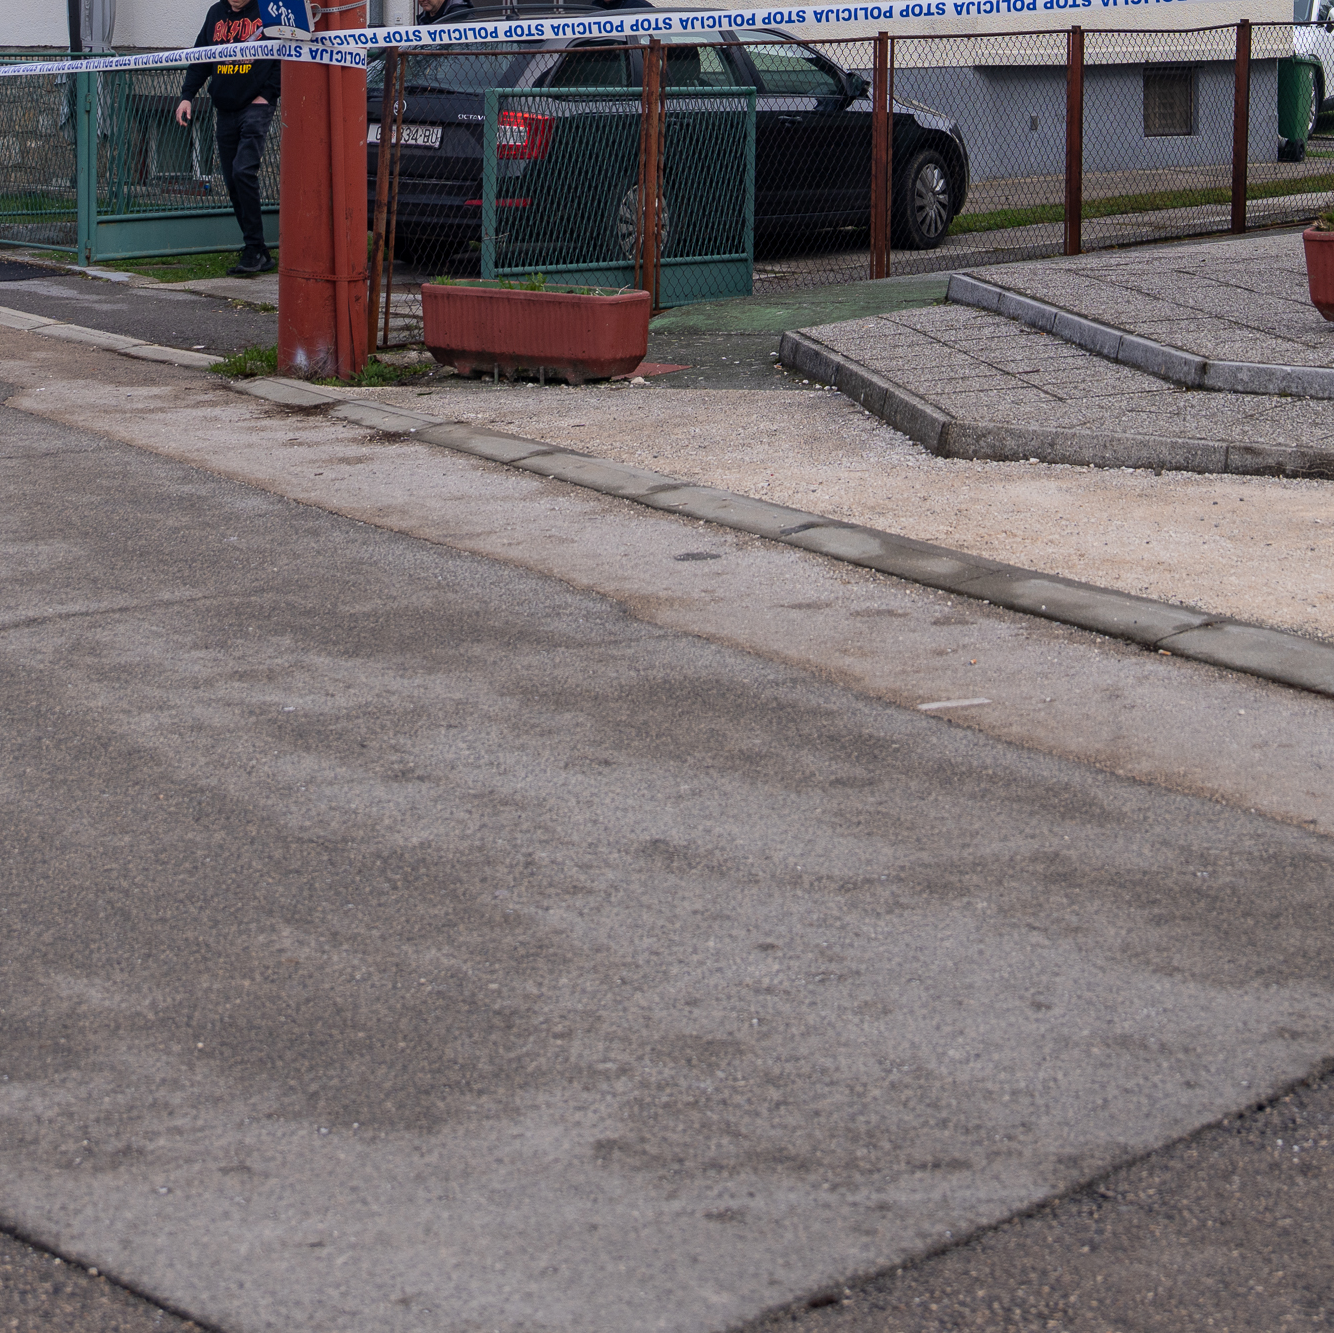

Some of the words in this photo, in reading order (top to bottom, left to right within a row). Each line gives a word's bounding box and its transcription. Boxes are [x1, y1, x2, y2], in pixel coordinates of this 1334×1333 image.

[762, 10, 806, 25] STOP
[813, 5, 893, 23] POLICIJA
[899, 2, 946, 18] STOP
[550, 20, 624, 36] POLICIJA
[630, 17, 672, 32] STOP
[679, 13, 755, 30] POLICIJA
[383, 29, 422, 43] STOP
[427, 26, 498, 42] POLICIJA
[504, 23, 544, 38] STOP
[164, 51, 183, 63] STOP
[186, 48, 217, 61] POLICIJA
[218, 46, 238, 59] STOP
[240, 44, 275, 58] POLICIJA
[277, 45, 303, 58] STOP
[309, 47, 366, 67] POLICIJA
